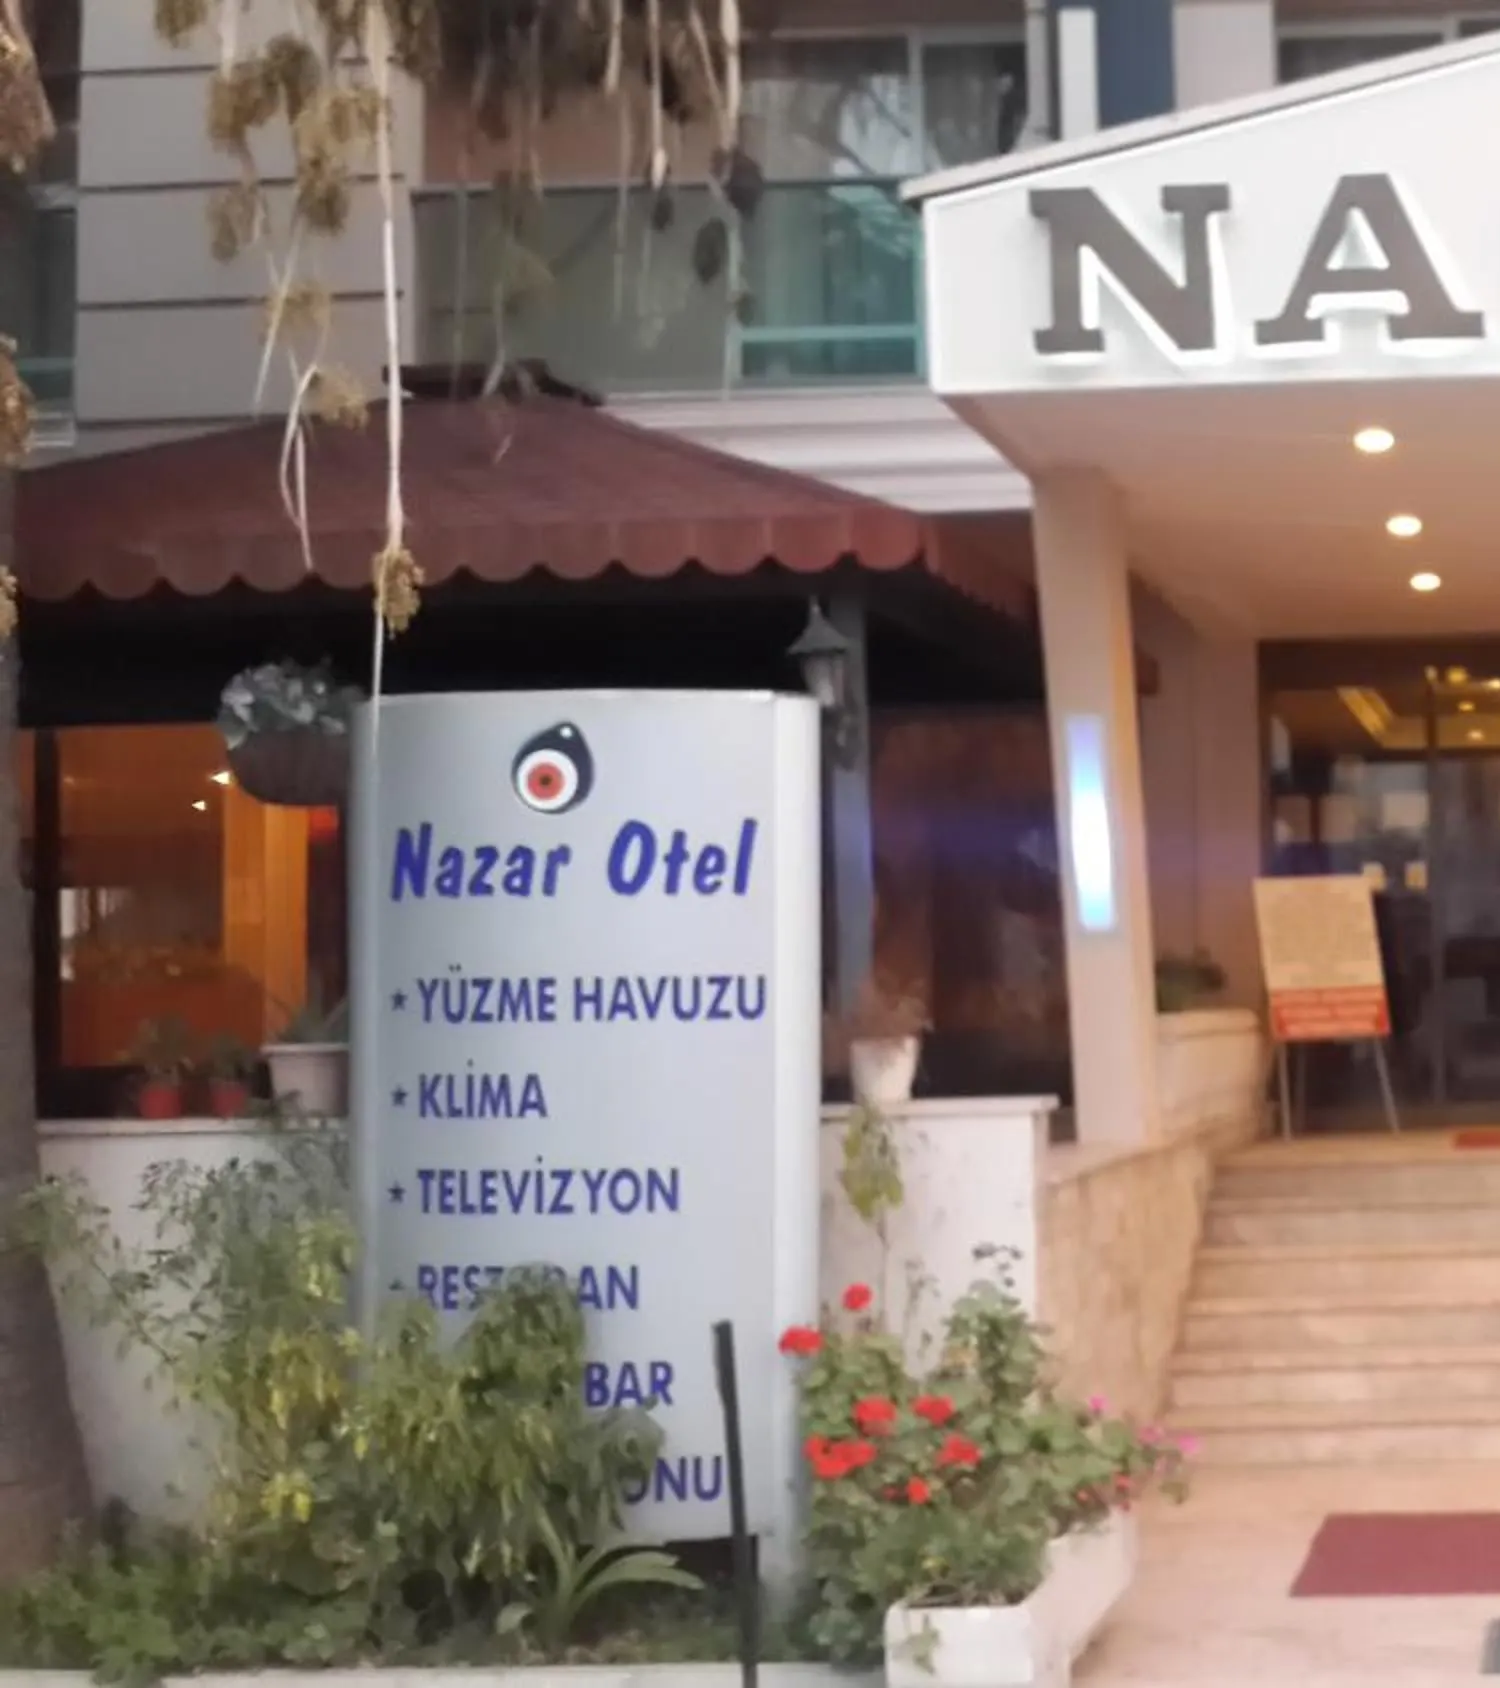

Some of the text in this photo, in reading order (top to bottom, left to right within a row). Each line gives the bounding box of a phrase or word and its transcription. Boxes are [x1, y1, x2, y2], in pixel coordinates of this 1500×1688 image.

[391, 818, 757, 901] Nazar Otel
[416, 964, 766, 1023] YÜZME HAVUZU
[419, 1059, 548, 1119] KLİMA
[417, 1155, 680, 1215] TELEVİZYON
[583, 1360, 674, 1407] BAR
